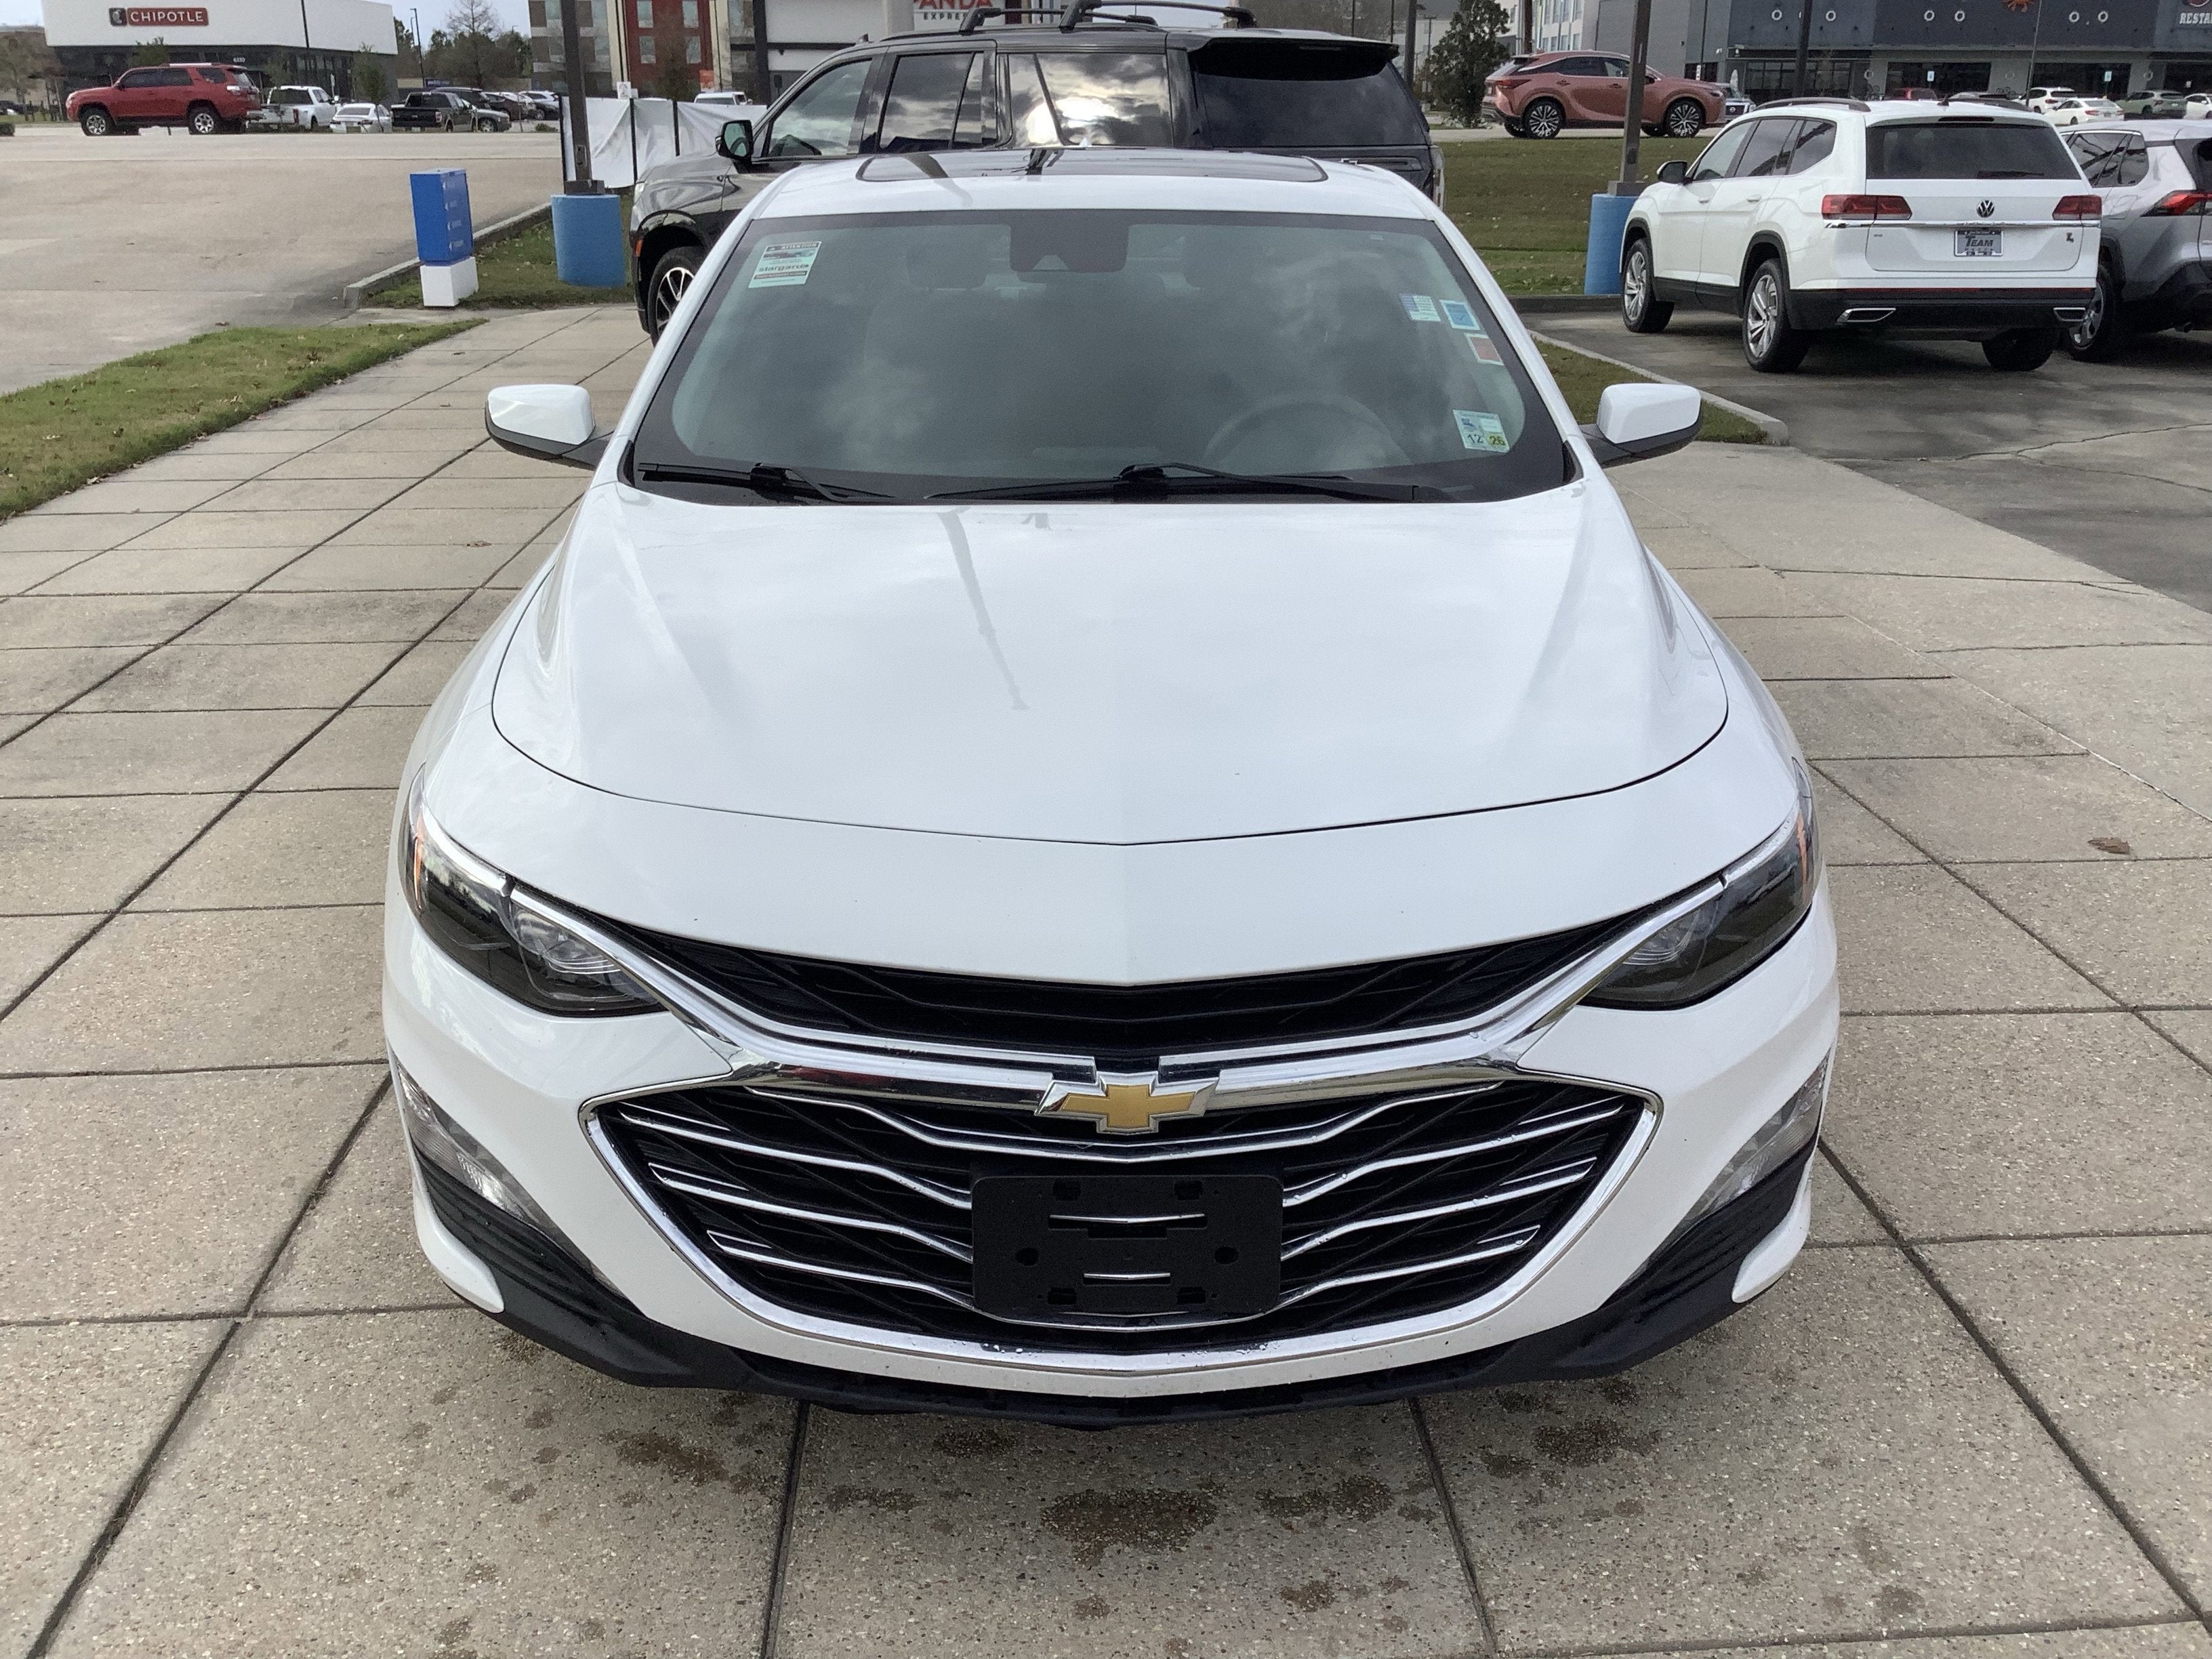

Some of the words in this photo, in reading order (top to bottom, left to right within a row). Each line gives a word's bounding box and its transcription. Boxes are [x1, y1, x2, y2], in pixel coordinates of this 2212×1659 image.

[914, 0, 992, 9] ANDA
[130, 11, 204, 22] CHIPOTLE
[923, 12, 968, 20] EXPRE
[2179, 12, 2212, 24] RESTA
[780, 243, 817, 251] ATTENTION
[1467, 434, 1484, 444] 12
[1489, 436, 1506, 446] 26
